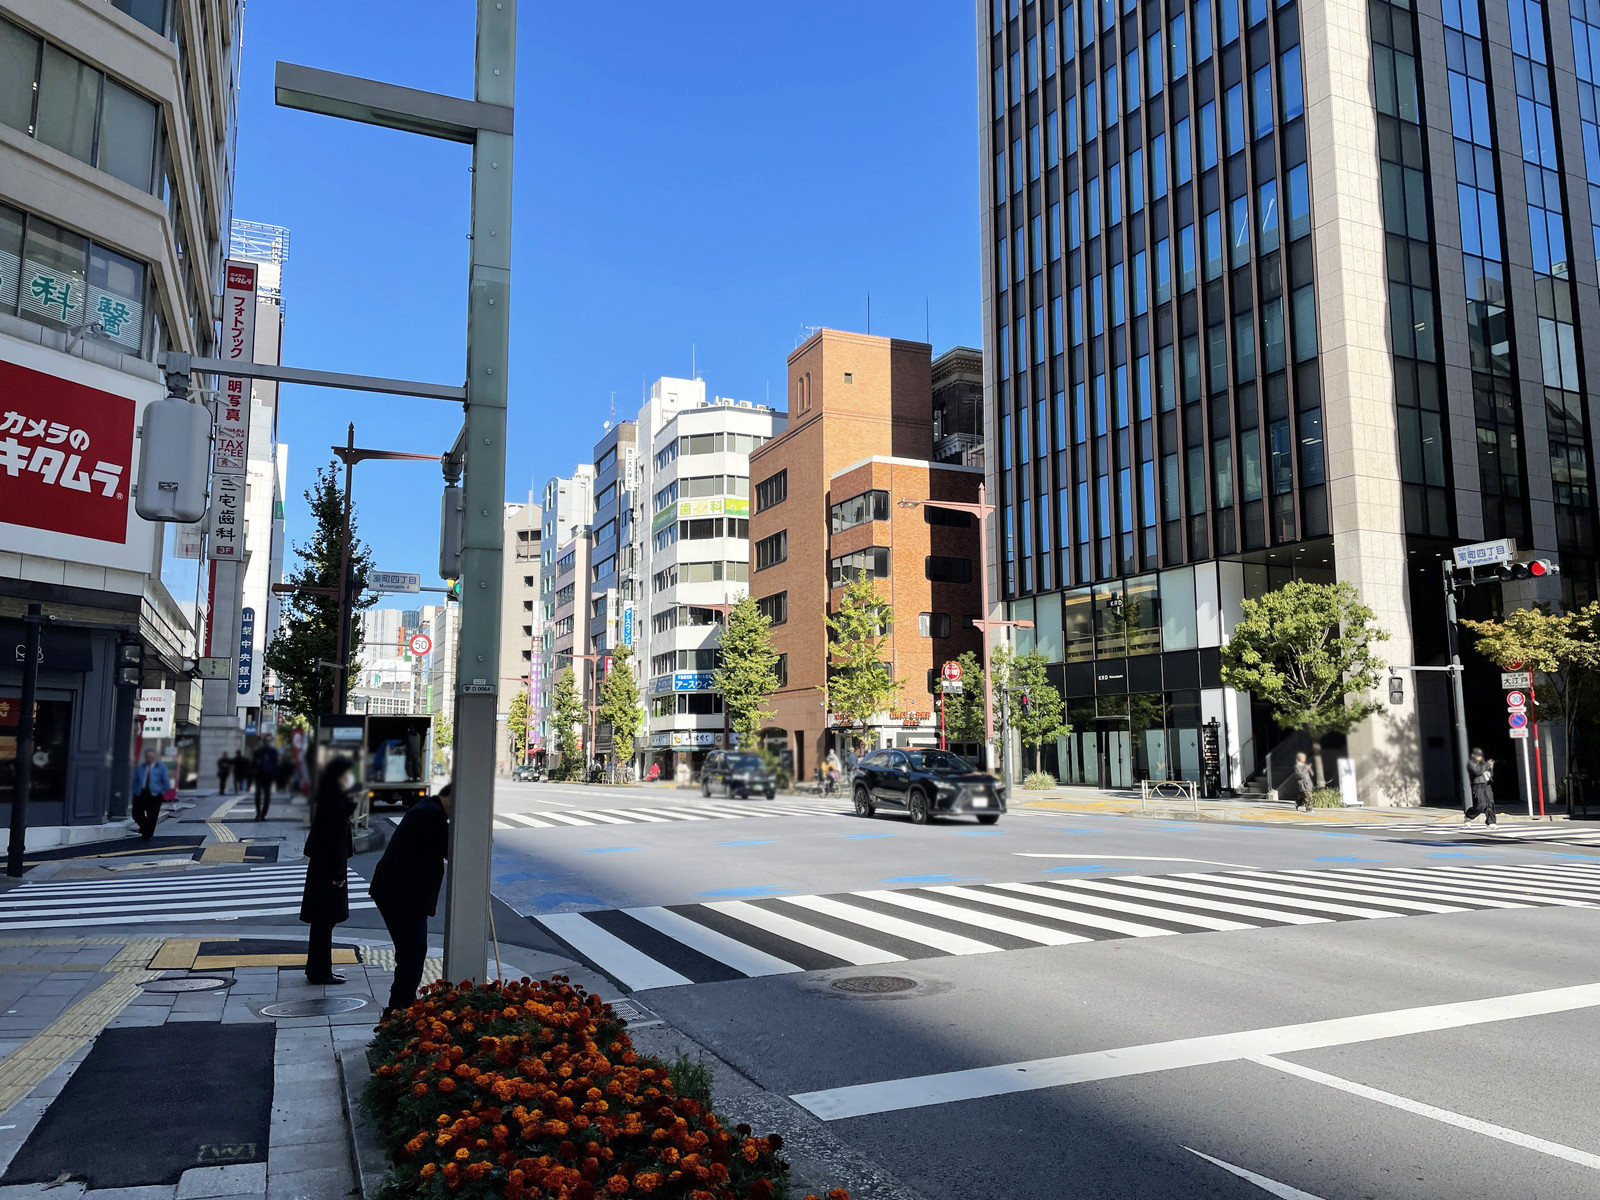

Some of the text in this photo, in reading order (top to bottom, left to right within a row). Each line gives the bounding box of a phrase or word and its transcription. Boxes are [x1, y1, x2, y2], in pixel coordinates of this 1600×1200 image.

[229, 277, 252, 285] キタムラ
[0, 274, 132, 337] 科醫
[230, 296, 246, 359] フォトブック
[225, 375, 243, 422] 明写真
[0, 411, 90, 451] カメラの
[219, 438, 243, 449] TAX
[0, 436, 124, 498] キタムラ
[1457, 546, 1505, 561] 室町四丁目
[373, 574, 417, 585] 室町四丁目
[238, 613, 254, 689] 山梨中央銀行
[415, 640, 428, 650] 50
[1511, 695, 1522, 703] 30
